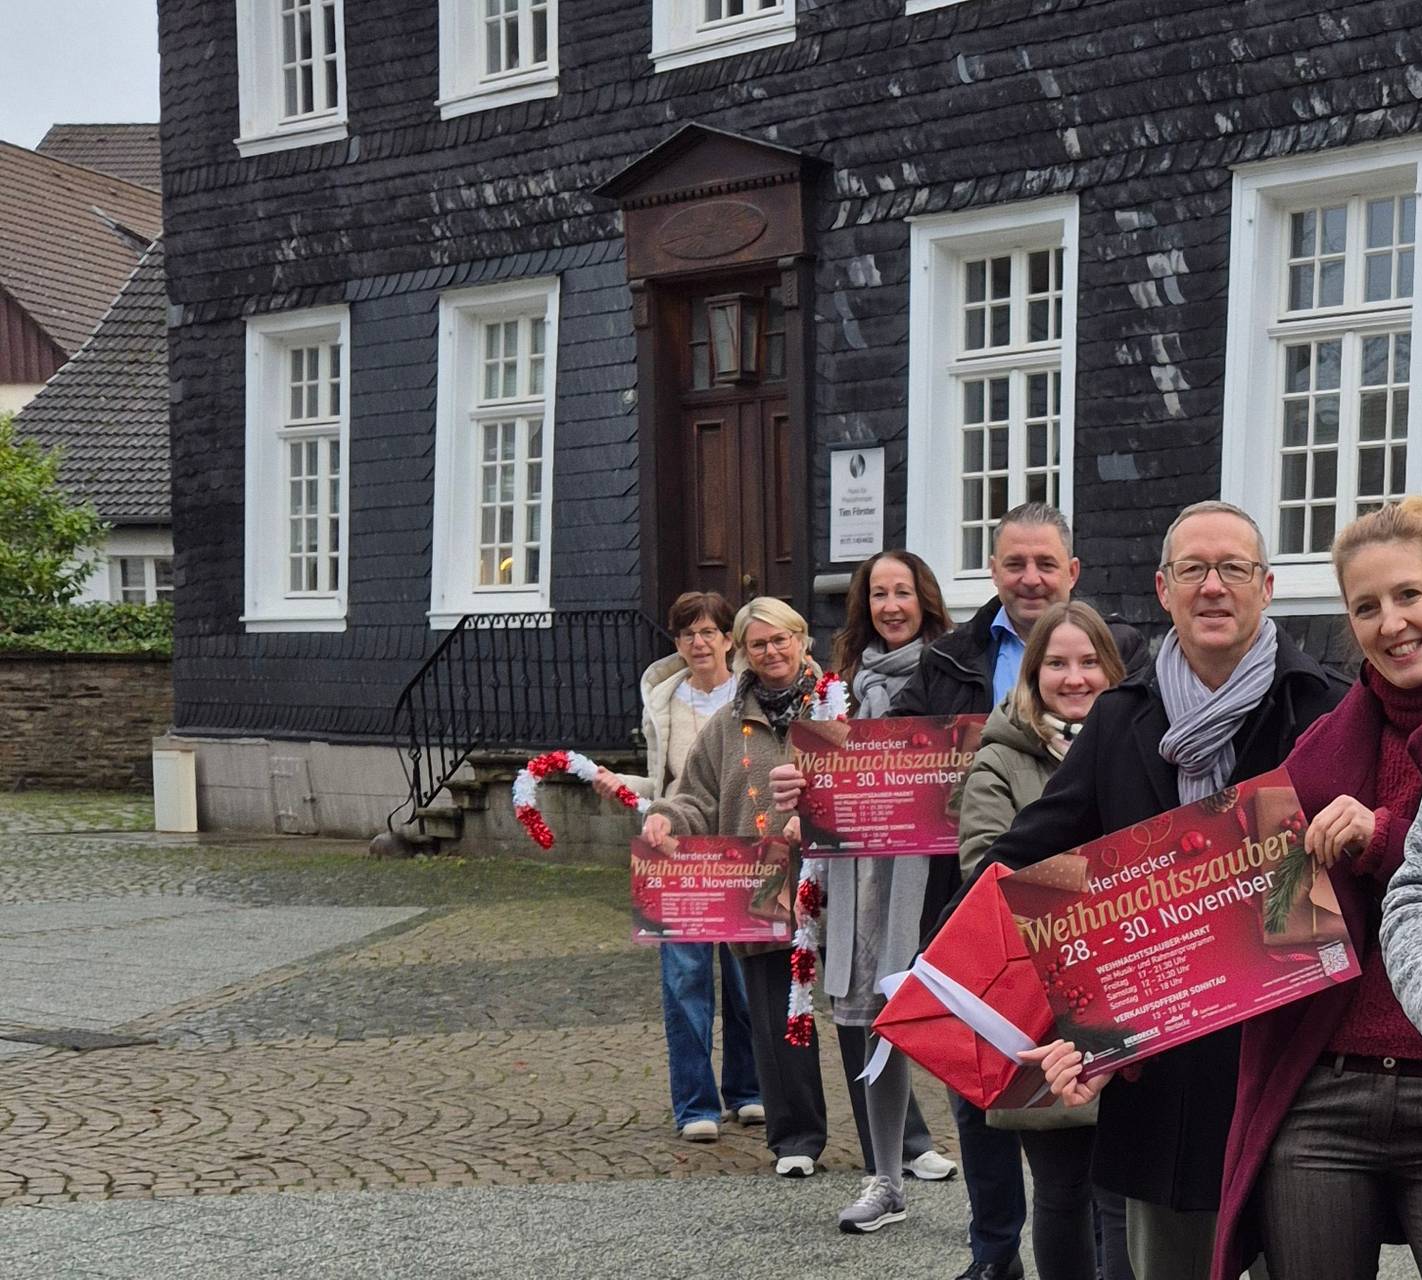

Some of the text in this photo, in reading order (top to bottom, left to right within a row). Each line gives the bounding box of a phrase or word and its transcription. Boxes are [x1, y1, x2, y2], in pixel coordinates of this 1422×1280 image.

[838, 507, 876, 517] Tim Förster
[845, 739, 907, 751] Herdecker
[797, 750, 977, 773] Weihnachtszaube
[814, 774, 838, 789] 28.
[856, 772, 880, 787] 30.
[884, 770, 965, 786] November
[672, 851, 722, 861] Herdecker
[633, 859, 781, 877] Weihnachtszauber
[1087, 850, 1177, 896] Herdecker
[647, 876, 666, 889] 28.
[680, 876, 699, 889] 30.
[702, 876, 766, 889] November
[1023, 830, 1294, 953] Weihnachtszauber
[1060, 938, 1098, 967] 28.
[1119, 916, 1157, 944] 30.
[1158, 870, 1276, 929] November
[1096, 924, 1211, 974] WEIHNACHTSZAUBER-MARKT
[1173, 955, 1188, 966] Uhr
[1176, 964, 1190, 975] Uhr
[1160, 981, 1169, 991] 18
[1169, 977, 1183, 988] Uhr
[1113, 989, 1190, 1024] VERKAUFSOFFENER
[1177, 1000, 1192, 1012] Uhr
